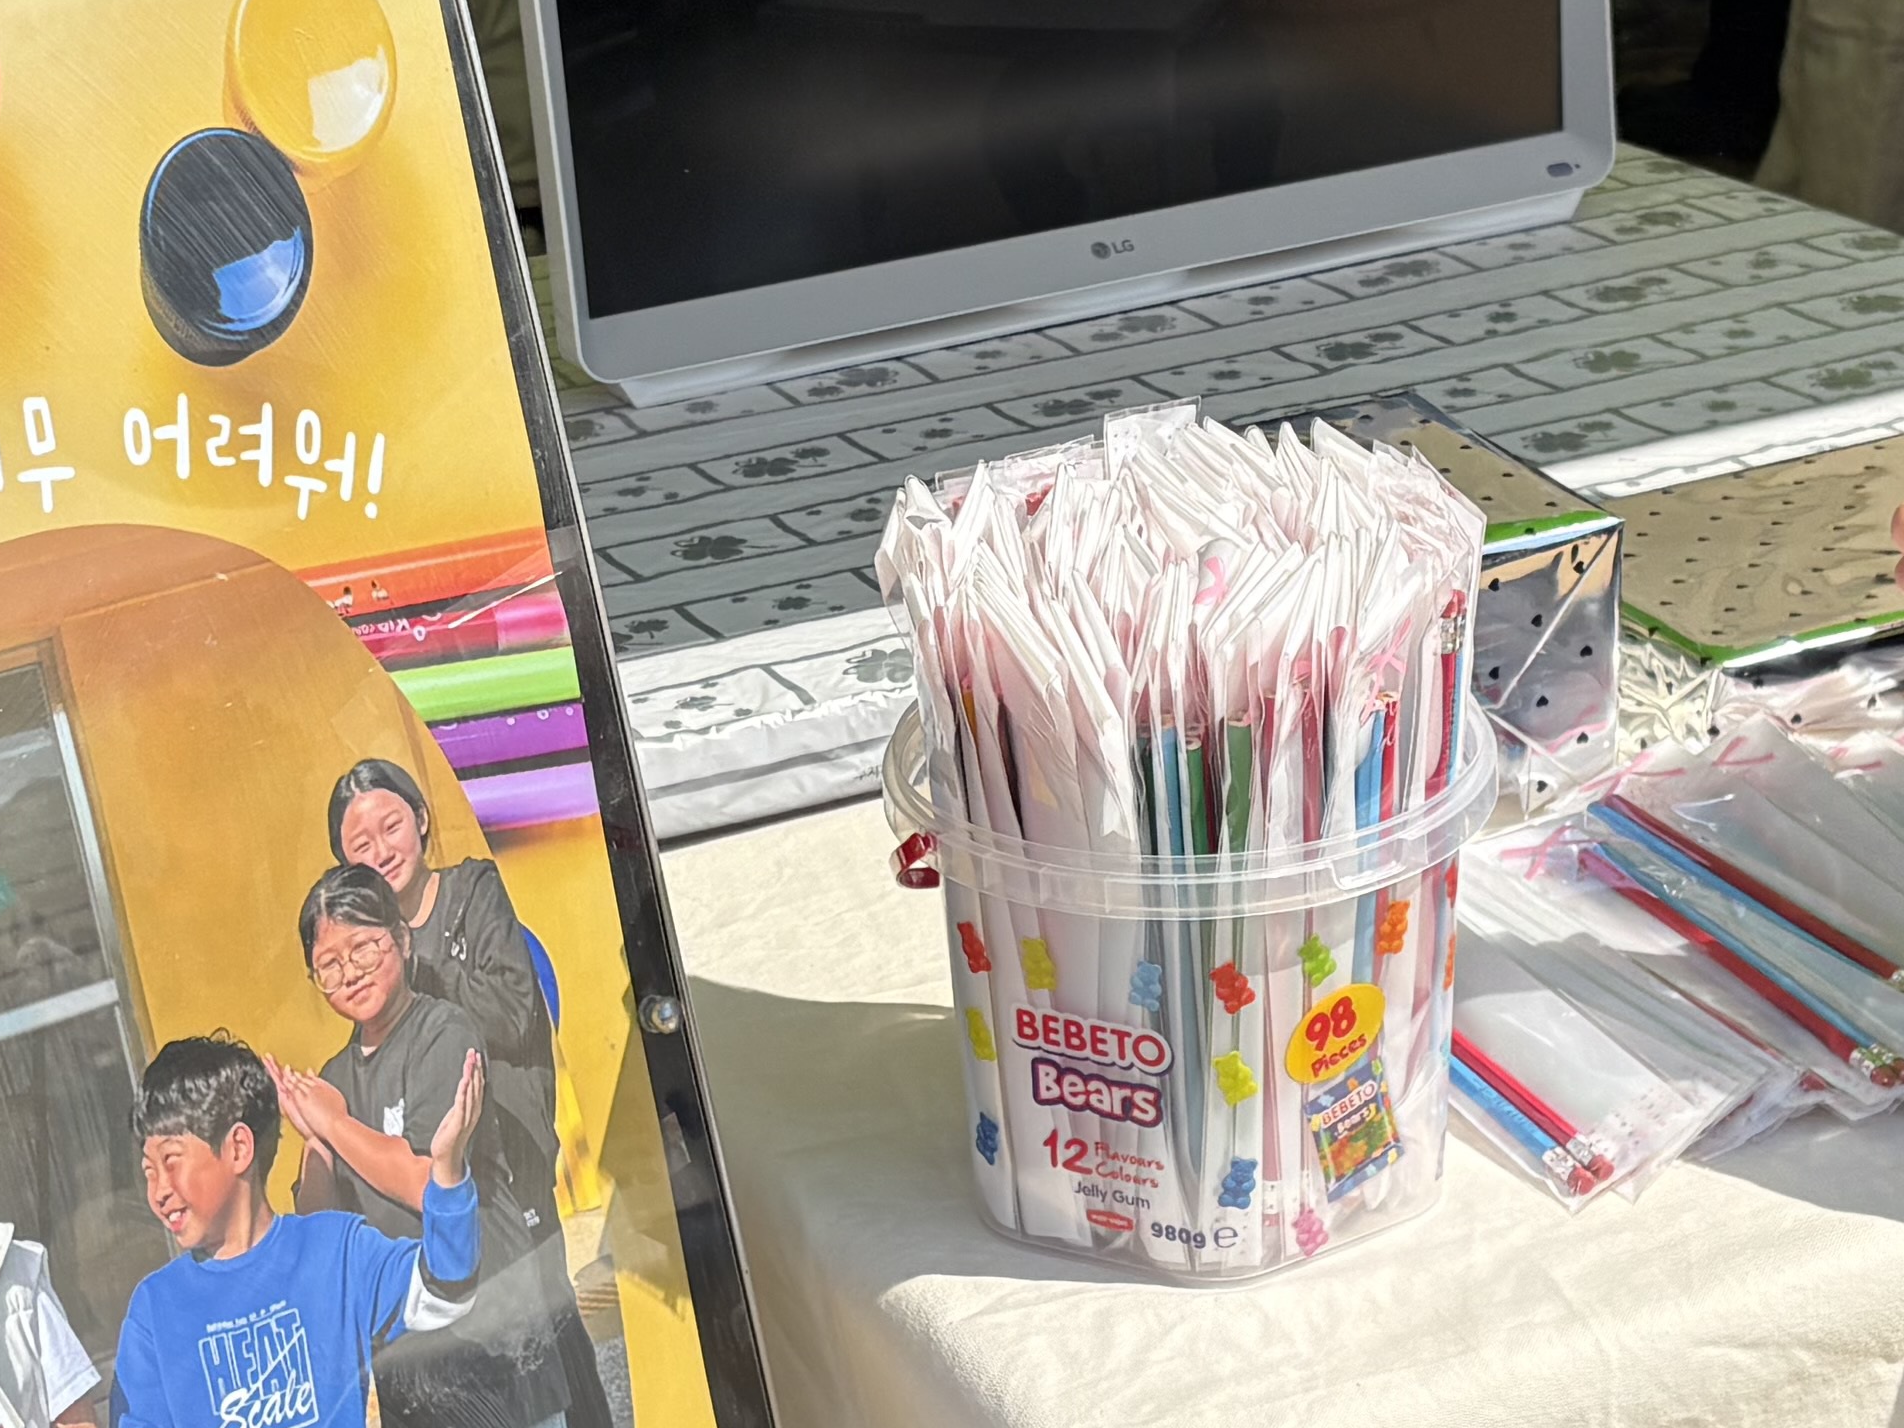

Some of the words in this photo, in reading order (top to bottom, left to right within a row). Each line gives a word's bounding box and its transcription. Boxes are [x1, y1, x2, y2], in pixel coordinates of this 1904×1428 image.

[1111, 239, 1135, 254] LG
[122, 393, 388, 520] 어려워!
[1015, 1007, 1166, 1068] BEBETO
[1305, 995, 1357, 1052] 98
[1034, 1061, 1161, 1124] Bears
[1043, 1128, 1093, 1175] 12
[1074, 1181, 1108, 1203] Jelly
[1112, 1189, 1151, 1210] Gum
